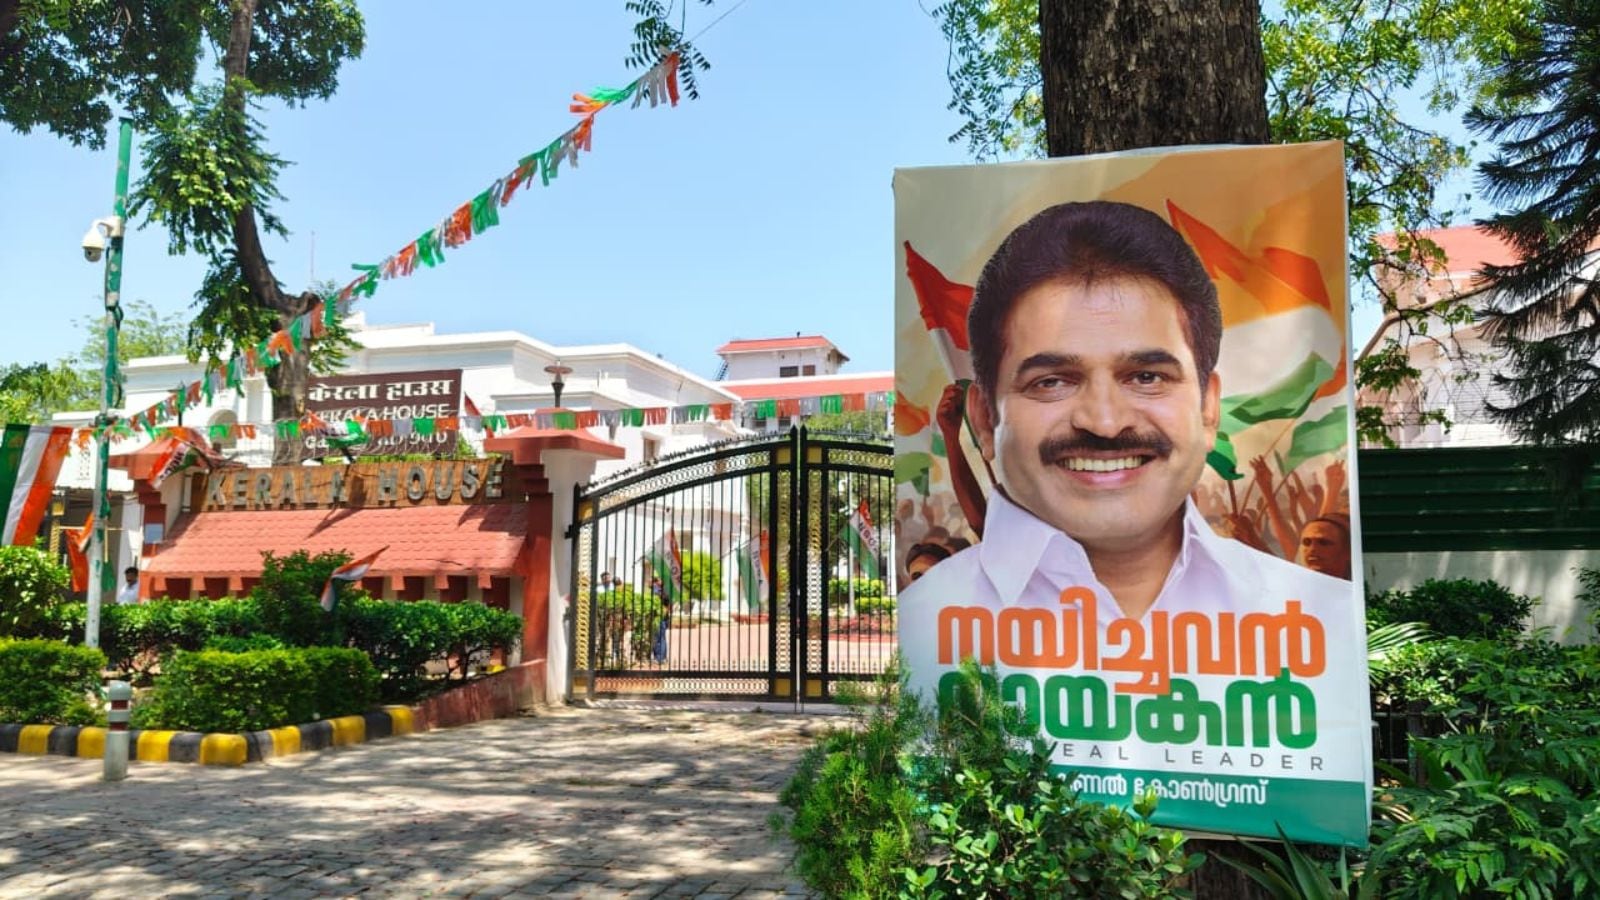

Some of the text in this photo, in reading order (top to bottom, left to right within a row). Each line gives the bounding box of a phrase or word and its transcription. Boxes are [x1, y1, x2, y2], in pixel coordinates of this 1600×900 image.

[308, 379, 454, 402] केरला हाउस
[383, 403, 450, 420] HOUSE
[207, 460, 504, 509] KERALA HOUSE
[937, 586, 1326, 695] നയിച്ചവൻ
[1060, 742, 1324, 771] EAL LEADER
